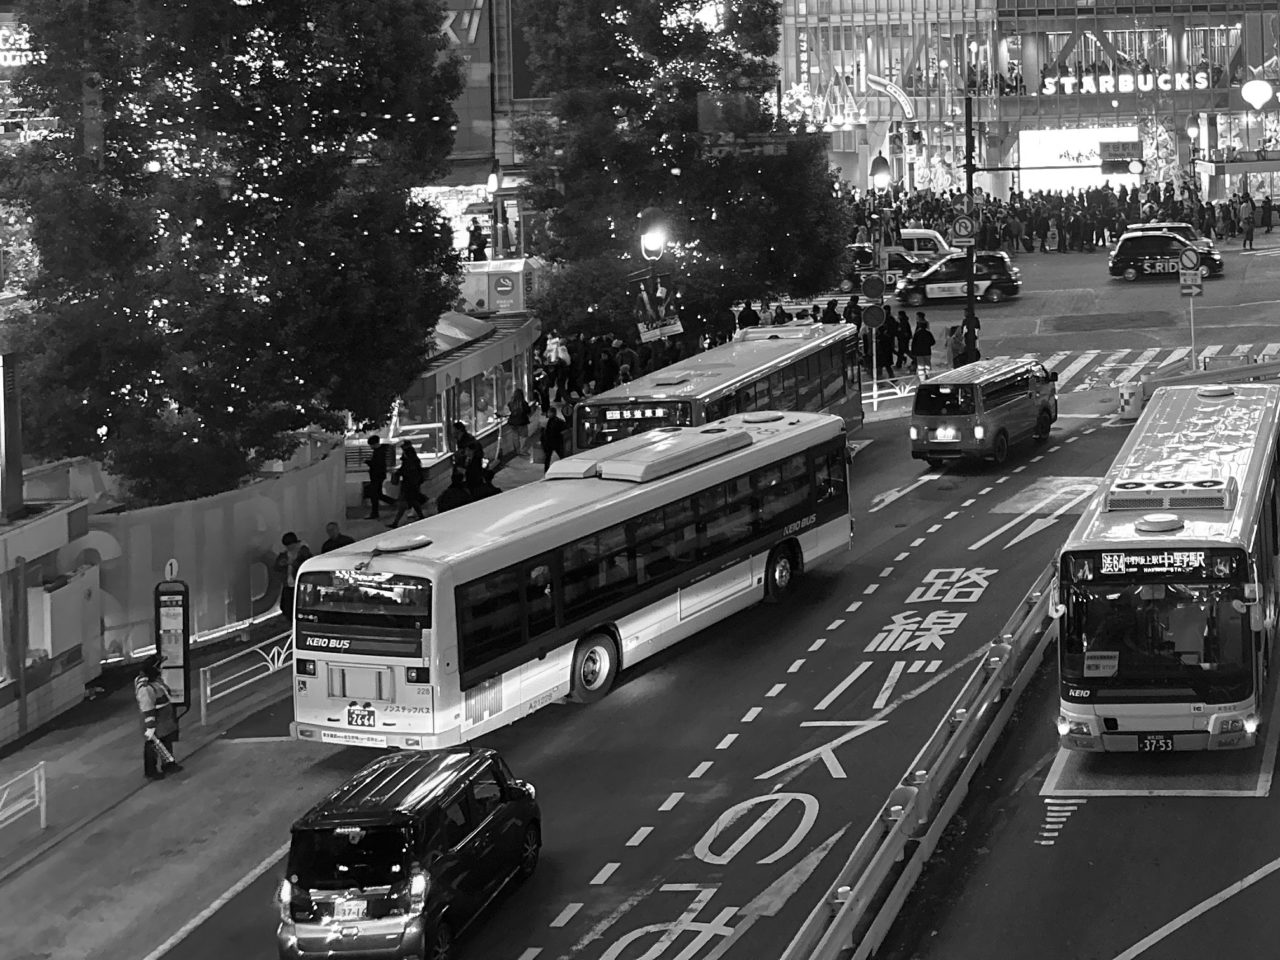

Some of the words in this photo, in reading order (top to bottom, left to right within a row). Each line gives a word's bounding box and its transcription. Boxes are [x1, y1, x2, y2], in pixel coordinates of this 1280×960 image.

[1042, 72, 1208, 94] STARBUCKS
[1143, 262, 1179, 274] S.RID
[1159, 551, 1206, 567] 中野駅
[169, 563, 174, 575] 1
[306, 637, 328, 646] KEIO
[331, 639, 350, 648] BUS
[1069, 689, 1090, 697] KEIO
[1144, 740, 1172, 751] 37-53
